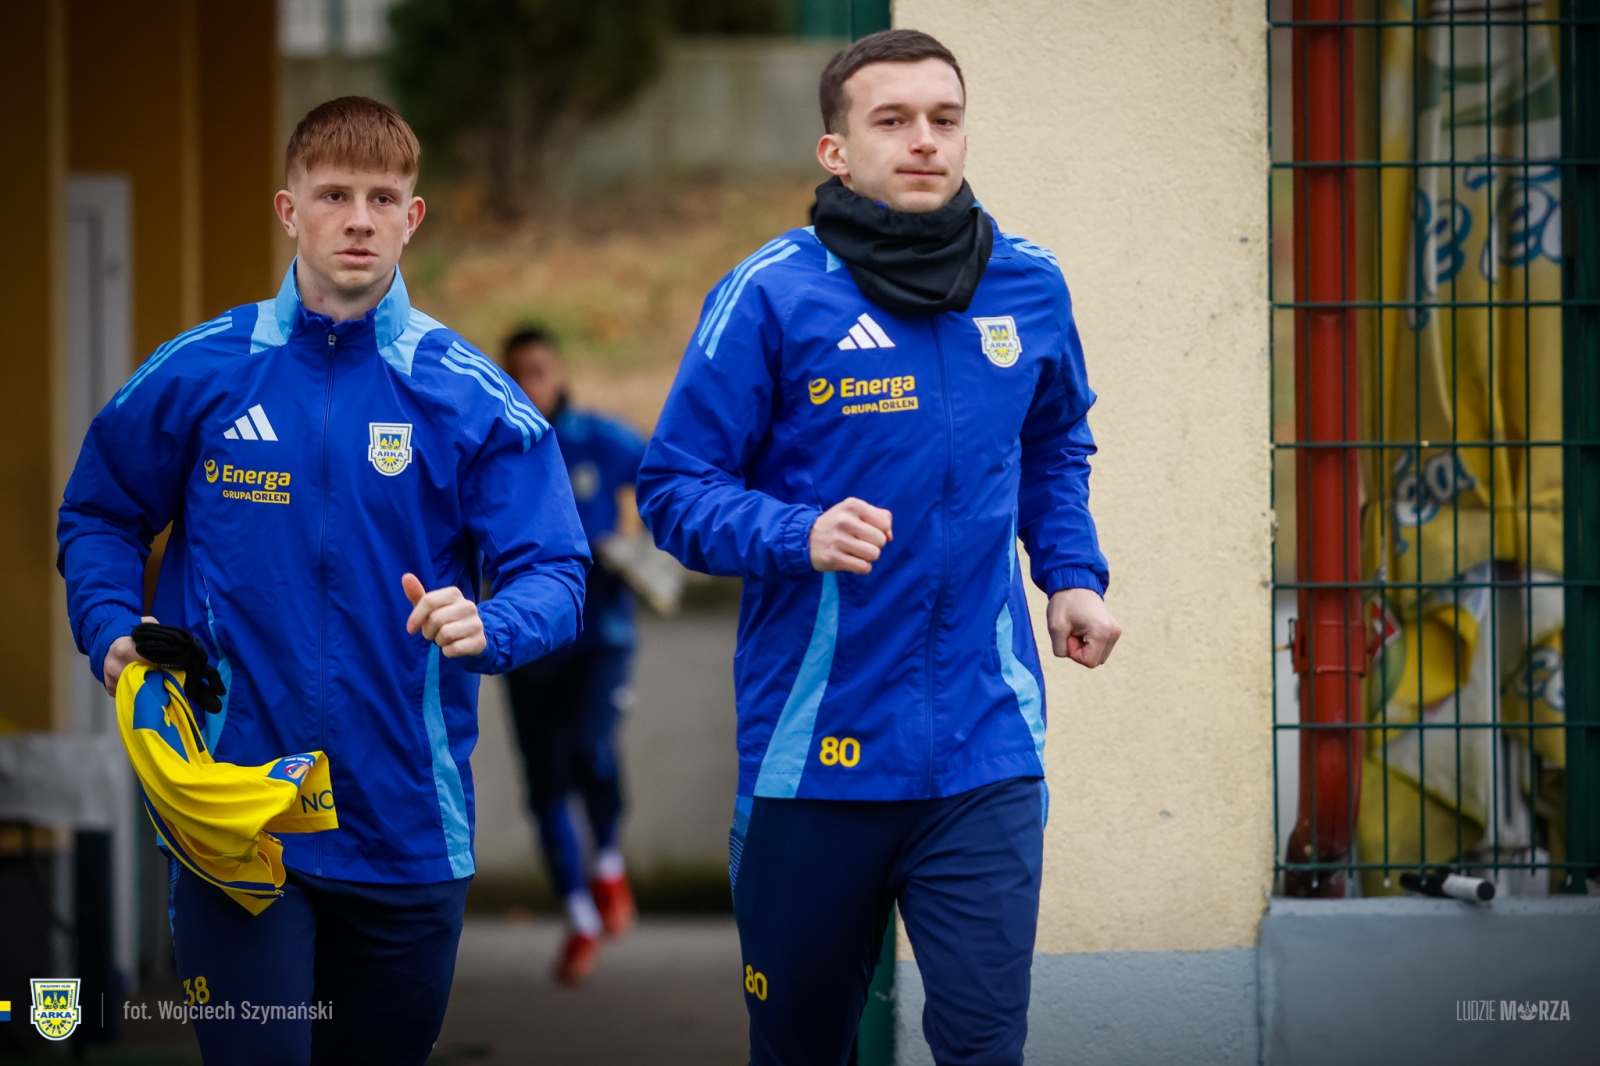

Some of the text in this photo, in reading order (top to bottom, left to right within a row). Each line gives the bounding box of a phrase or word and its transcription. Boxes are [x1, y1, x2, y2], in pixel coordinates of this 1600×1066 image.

[840, 375, 915, 398] Energa
[842, 399, 916, 415] GRUPA ORLEN
[222, 464, 291, 490] Energa
[222, 489, 288, 503] GRUPA ORLEN
[819, 736, 861, 767] 80
[183, 975, 210, 1007] 38
[745, 964, 768, 1001] 80
